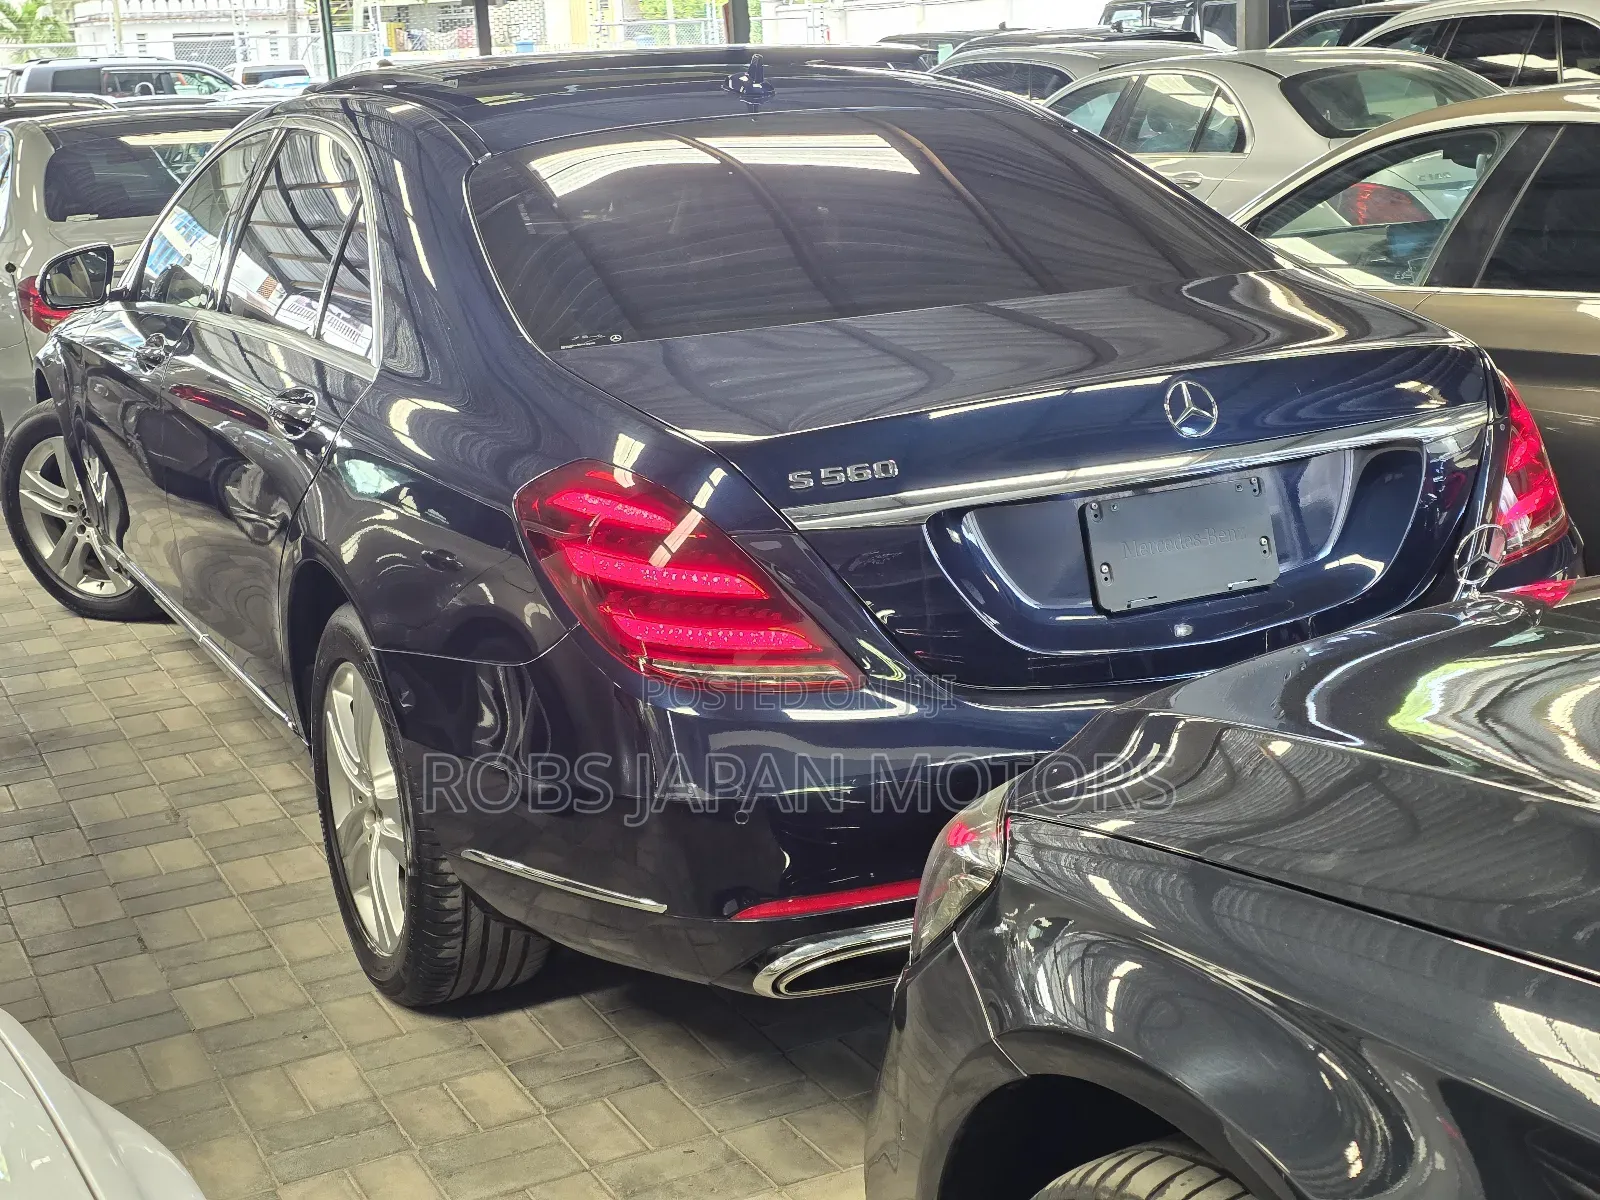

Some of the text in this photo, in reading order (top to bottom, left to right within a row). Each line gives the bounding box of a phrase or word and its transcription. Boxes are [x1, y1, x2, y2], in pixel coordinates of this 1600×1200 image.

[788, 460, 899, 490] S 560
[1120, 526, 1249, 560] Mercedes-Benz
